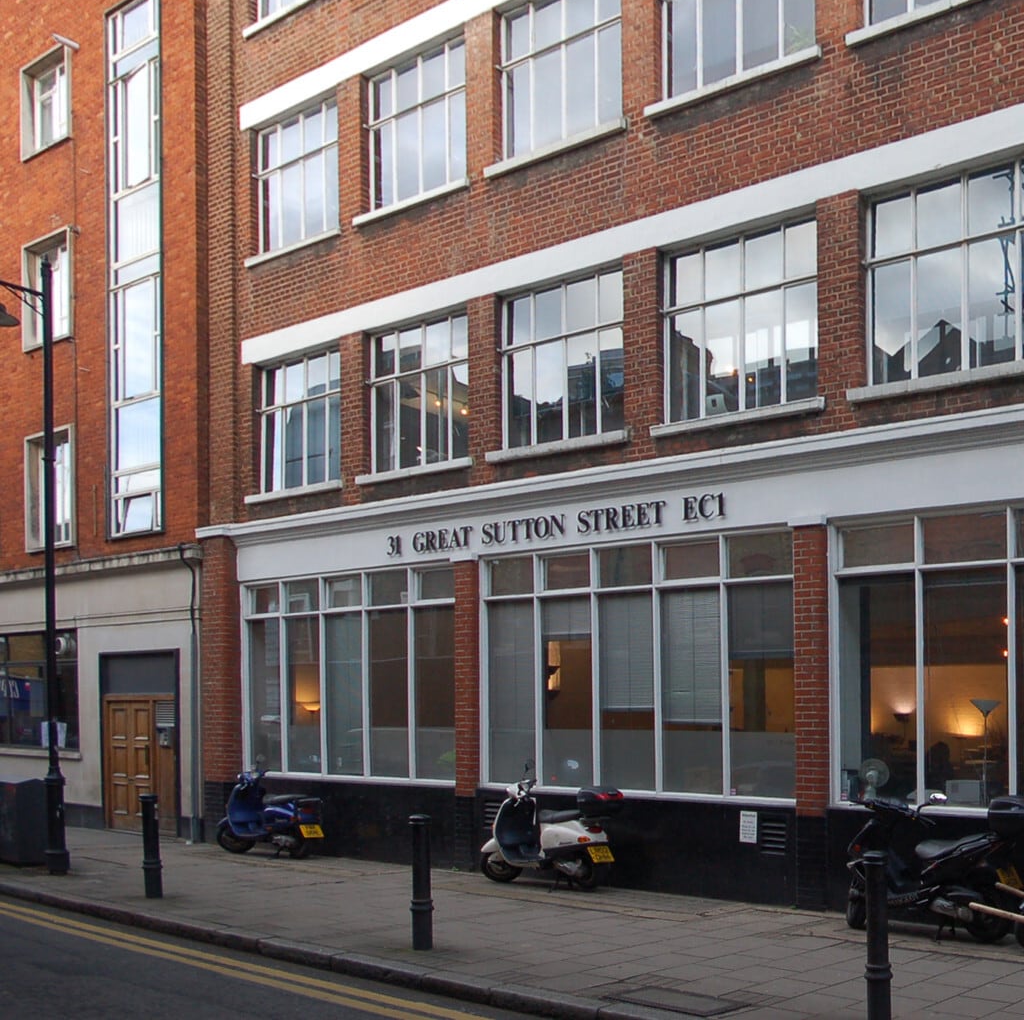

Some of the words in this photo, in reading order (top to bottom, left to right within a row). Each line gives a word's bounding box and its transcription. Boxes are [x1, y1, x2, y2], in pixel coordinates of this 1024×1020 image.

[386, 535, 402, 557] 31
[412, 525, 472, 554] GREAT
[481, 513, 566, 545] SUTTON
[576, 500, 667, 533] STREET
[681, 492, 727, 523] EC1
